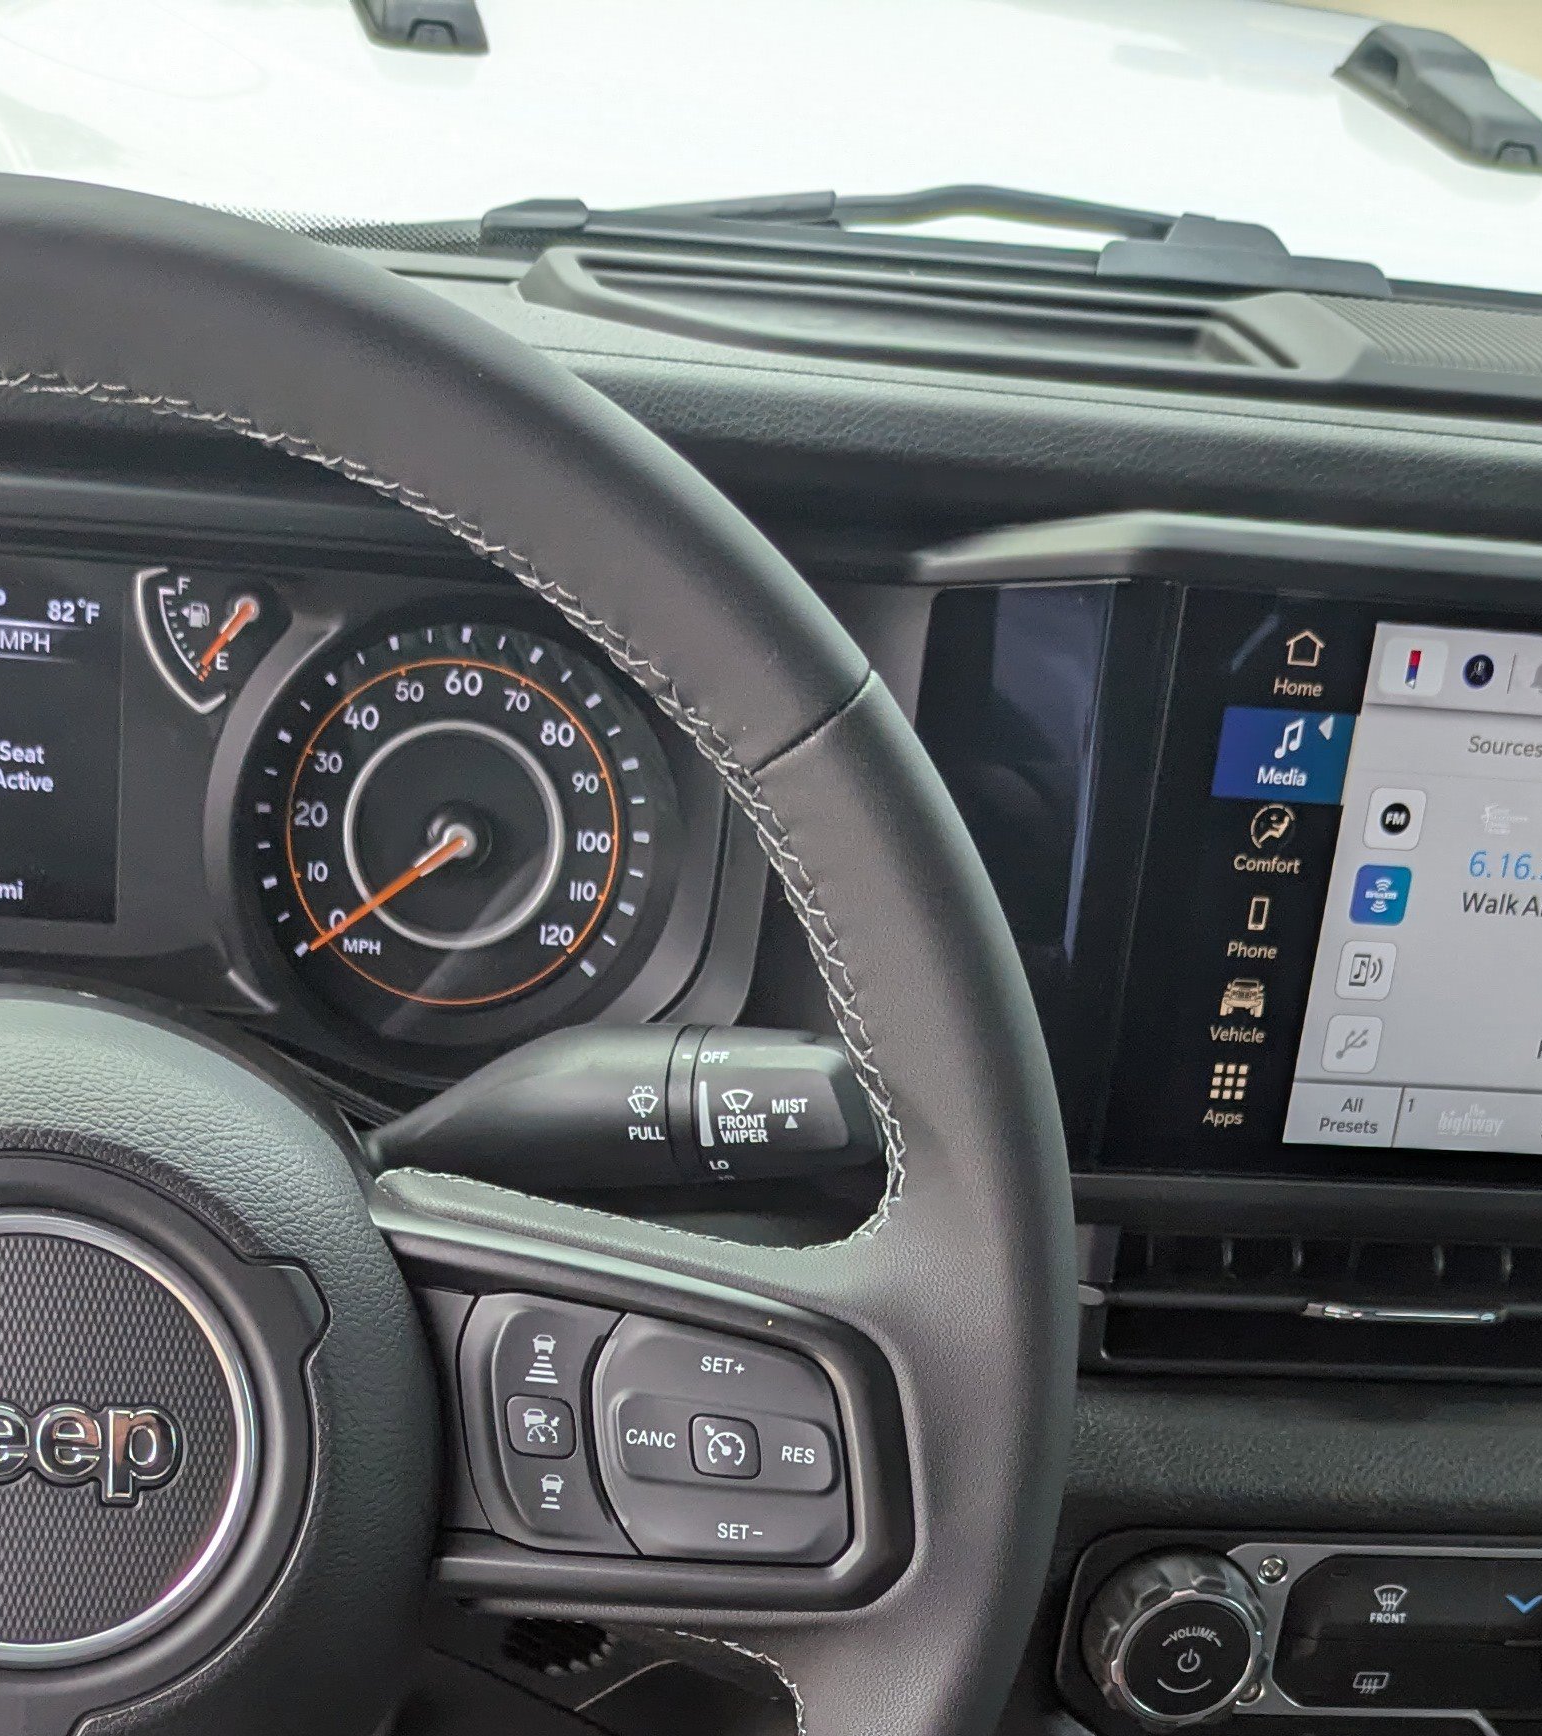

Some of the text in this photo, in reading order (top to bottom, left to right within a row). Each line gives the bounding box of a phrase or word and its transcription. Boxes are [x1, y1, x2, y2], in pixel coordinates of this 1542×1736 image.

[395, 681, 424, 702] 50
[445, 671, 482, 696] 60
[1273, 679, 1322, 698] Home
[504, 690, 529, 712] 70
[344, 706, 379, 731] 40
[540, 723, 574, 747] 80
[315, 752, 342, 773] 30
[572, 773, 598, 793] 90
[1257, 767, 1306, 787] Media
[295, 802, 328, 827] 20
[576, 831, 611, 853] 100
[308, 863, 328, 883] 10
[1234, 854, 1300, 875] Comfort
[569, 882, 596, 902] 110
[1461, 892, 1517, 918] Walk
[540, 925, 574, 946] 120
[343, 938, 381, 955] MPH
[1227, 941, 1277, 960] Phone
[1210, 1026, 1264, 1045] Vehicle
[700, 1051, 729, 1063] OFF
[771, 1098, 808, 1114] MIST
[1341, 1098, 1362, 1114] All
[718, 1114, 766, 1130] FRONT
[1203, 1109, 1243, 1128] Apps
[1319, 1117, 1378, 1135] Presets
[628, 1126, 665, 1141] PULL
[720, 1129, 768, 1143] WIPER
[626, 1429, 676, 1449] CANC
[781, 1446, 815, 1465] RES
[1370, 1612, 1406, 1624] FRONT
[1169, 1626, 1216, 1642] VOLUME
